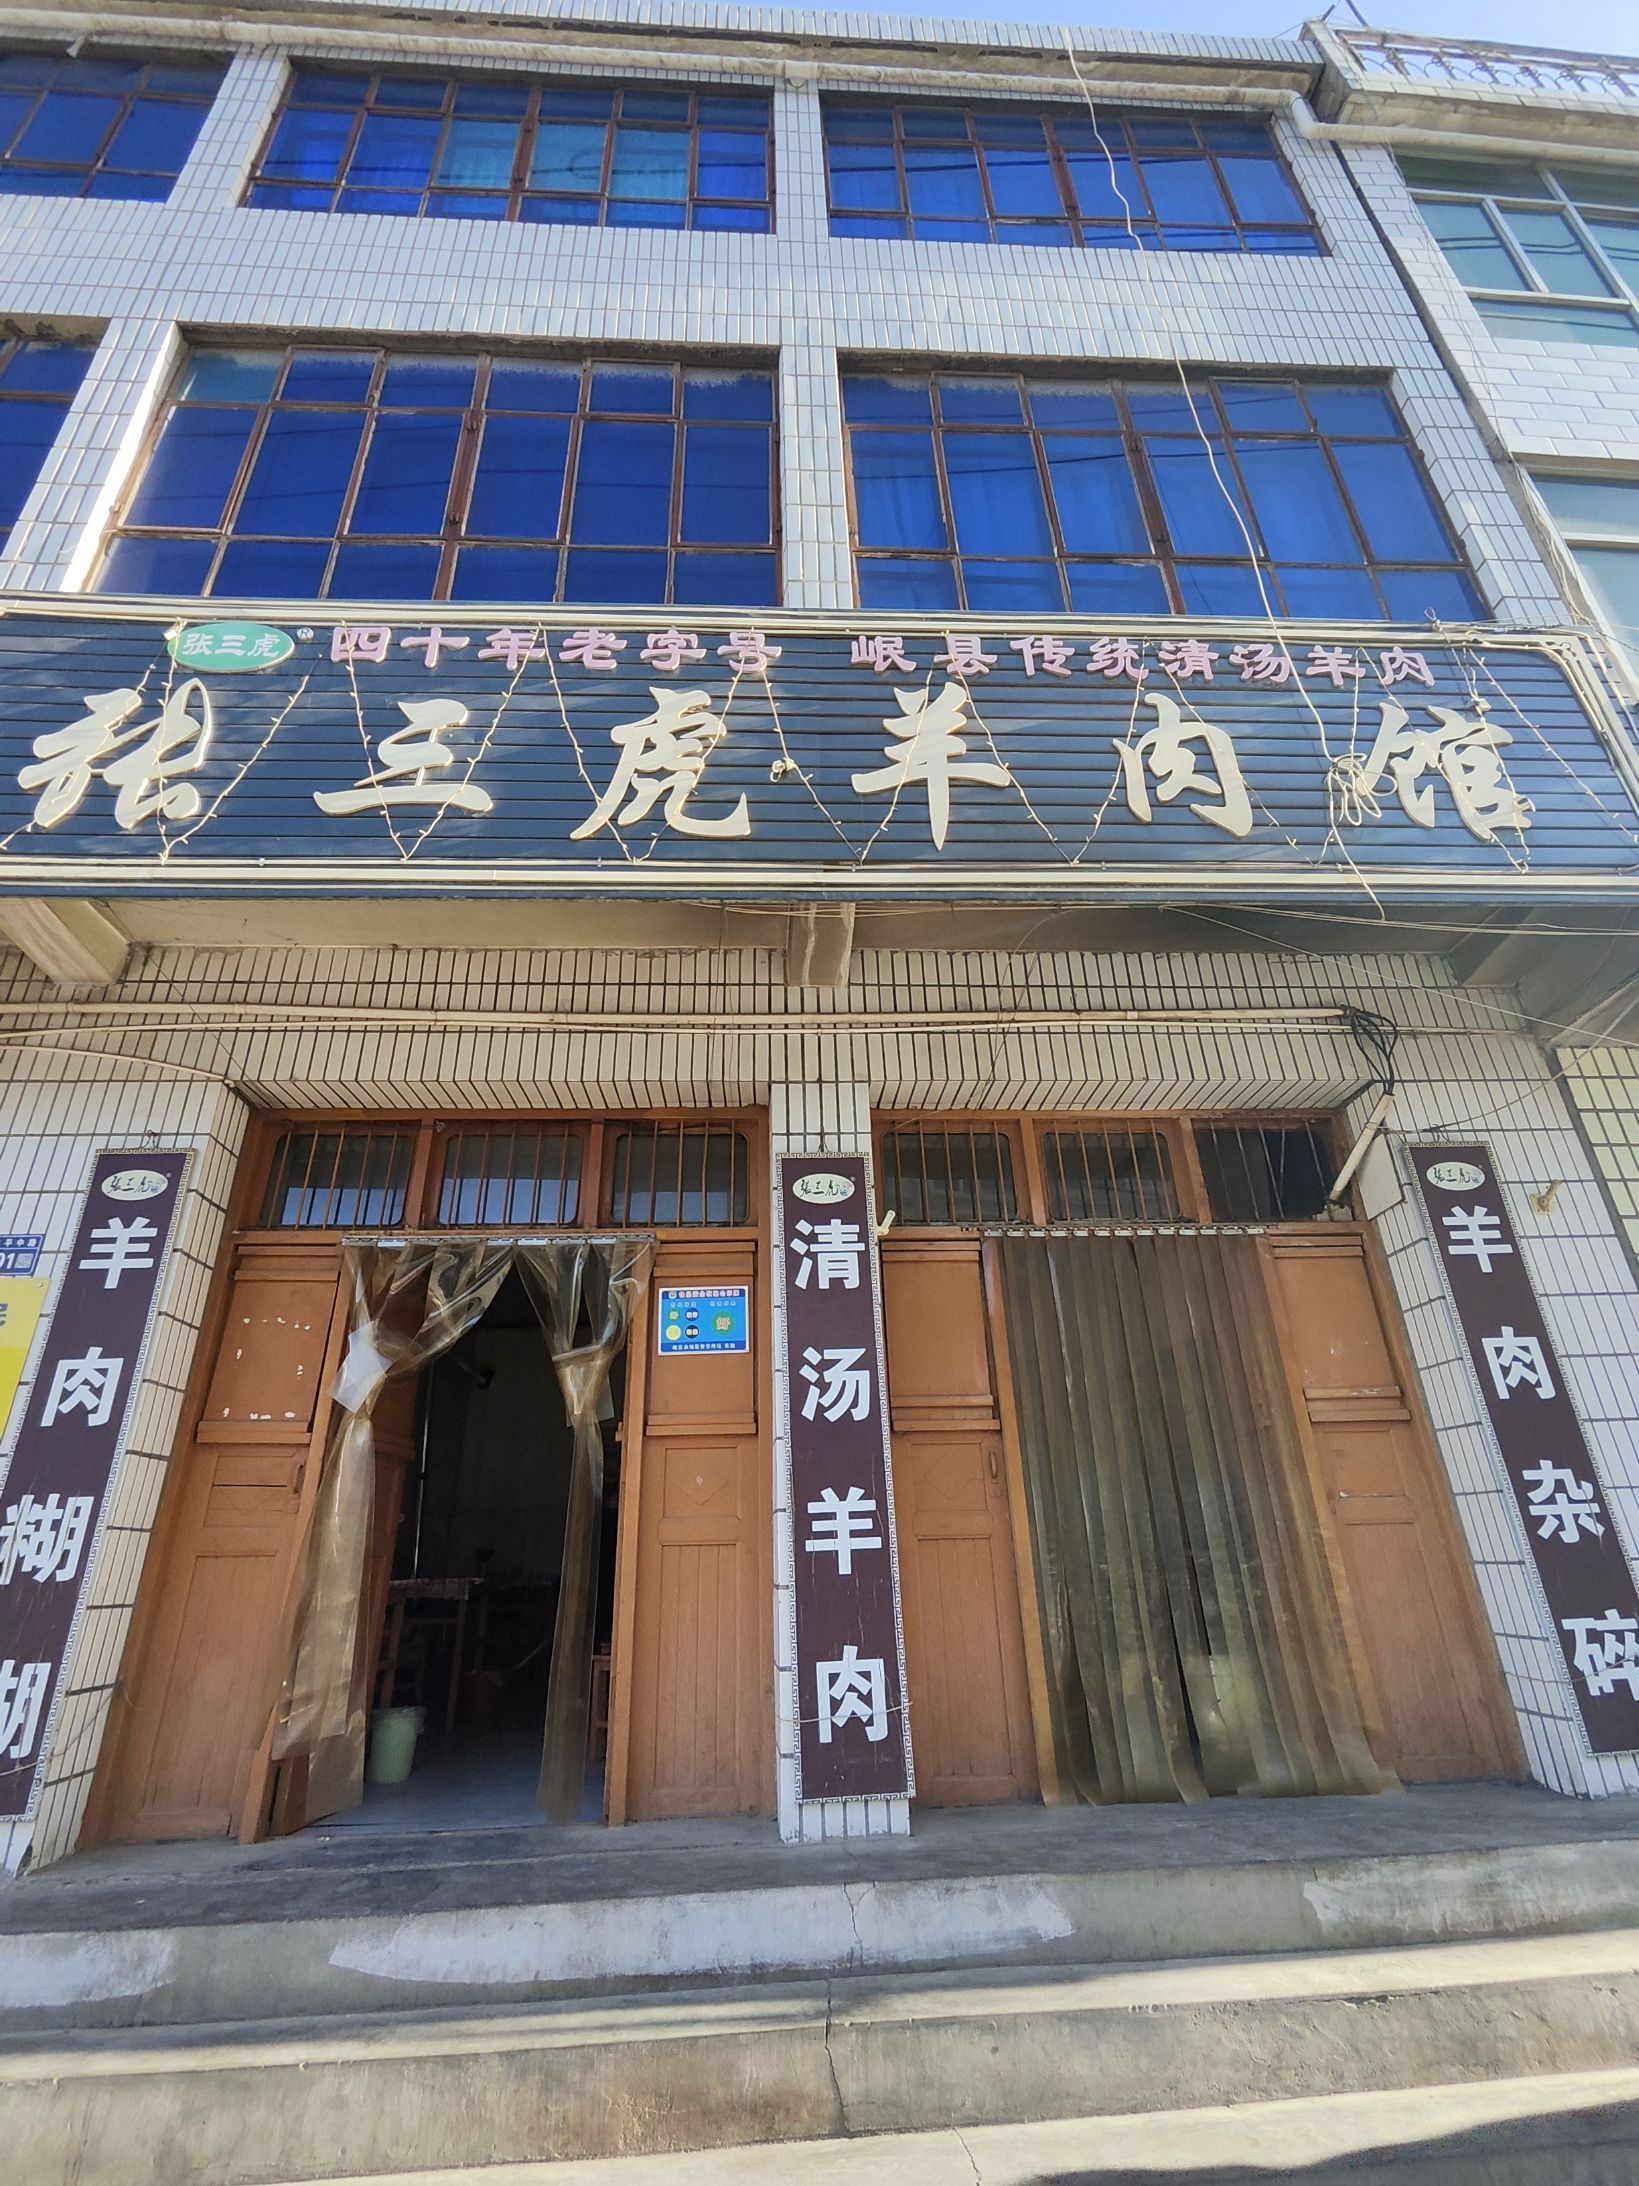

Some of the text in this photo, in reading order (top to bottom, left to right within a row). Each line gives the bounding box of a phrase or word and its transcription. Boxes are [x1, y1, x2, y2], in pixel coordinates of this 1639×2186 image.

[181, 632, 280, 657] 张三虎
[330, 625, 1436, 688] 四十年老字号 岷县传统清汤羊肉
[17, 678, 1537, 852] 张三虎羊肉馆
[789, 1218, 889, 1744] 清汤羊肉
[1441, 1205, 1639, 1701] 羊肉杂碎
